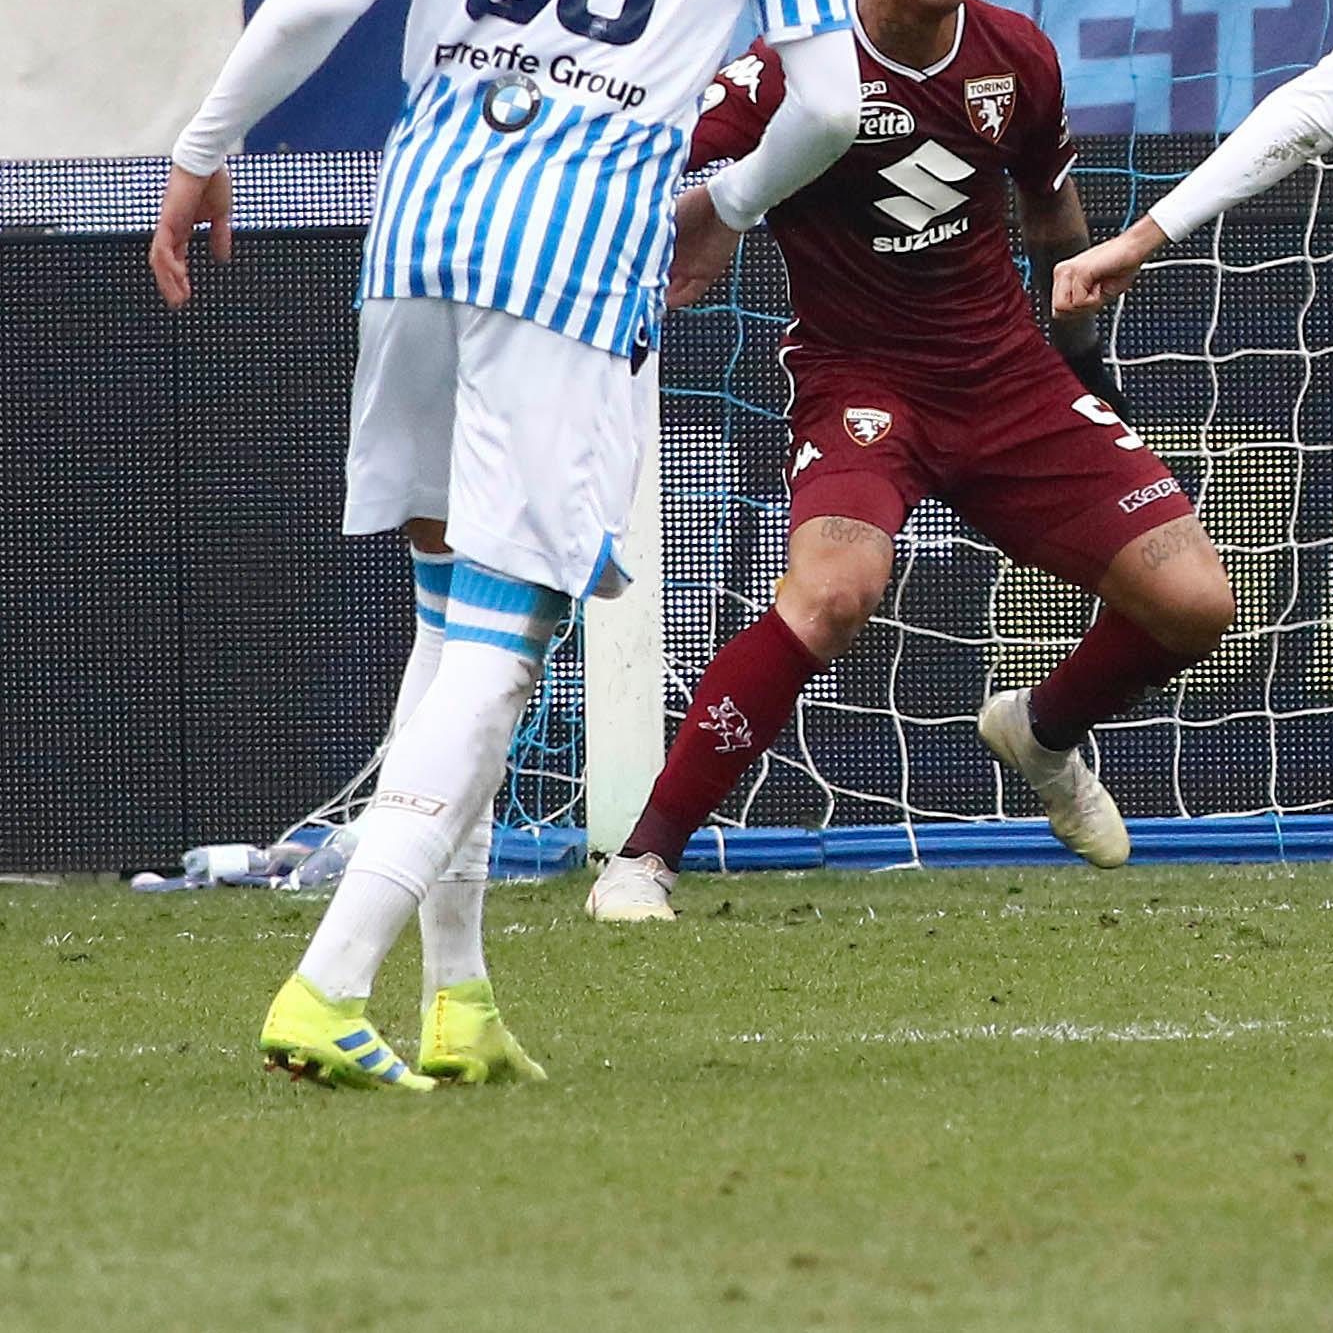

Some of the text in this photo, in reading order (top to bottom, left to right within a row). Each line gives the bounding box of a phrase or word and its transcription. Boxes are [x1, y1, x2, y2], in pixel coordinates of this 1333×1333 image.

[548, 54, 647, 110] Group
[969, 80, 1012, 95] TORINO
[997, 95, 1011, 106] FC
[872, 216, 970, 254] SUZUKI
